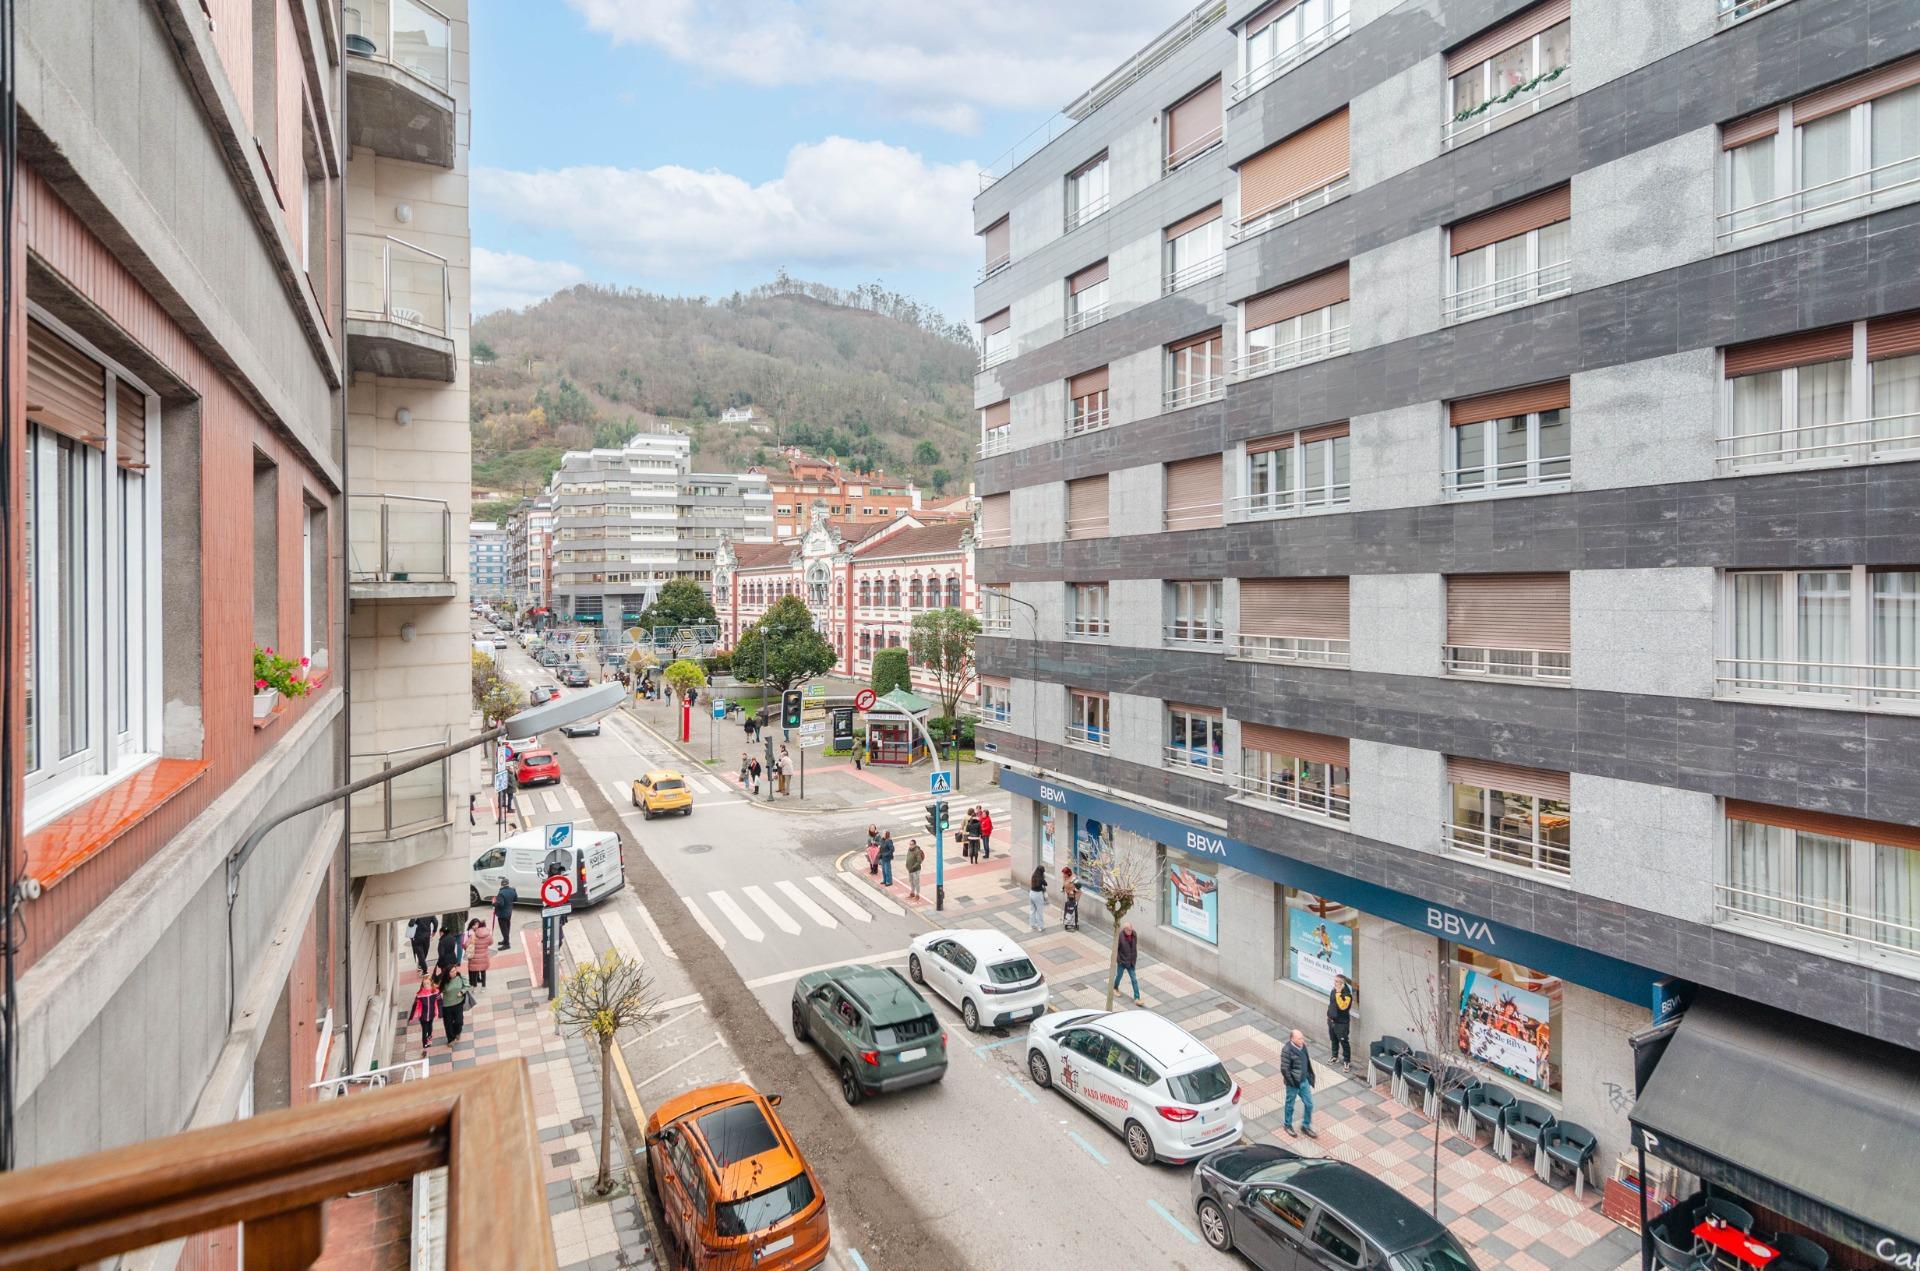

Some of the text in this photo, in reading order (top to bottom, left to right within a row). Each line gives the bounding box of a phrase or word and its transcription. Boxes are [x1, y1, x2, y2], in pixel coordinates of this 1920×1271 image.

[1040, 785, 1066, 804] BBVA
[1187, 832, 1227, 857] BBVA
[1427, 907, 1496, 945] BBVA
[1083, 1086, 1129, 1111] PASO HONROSO
